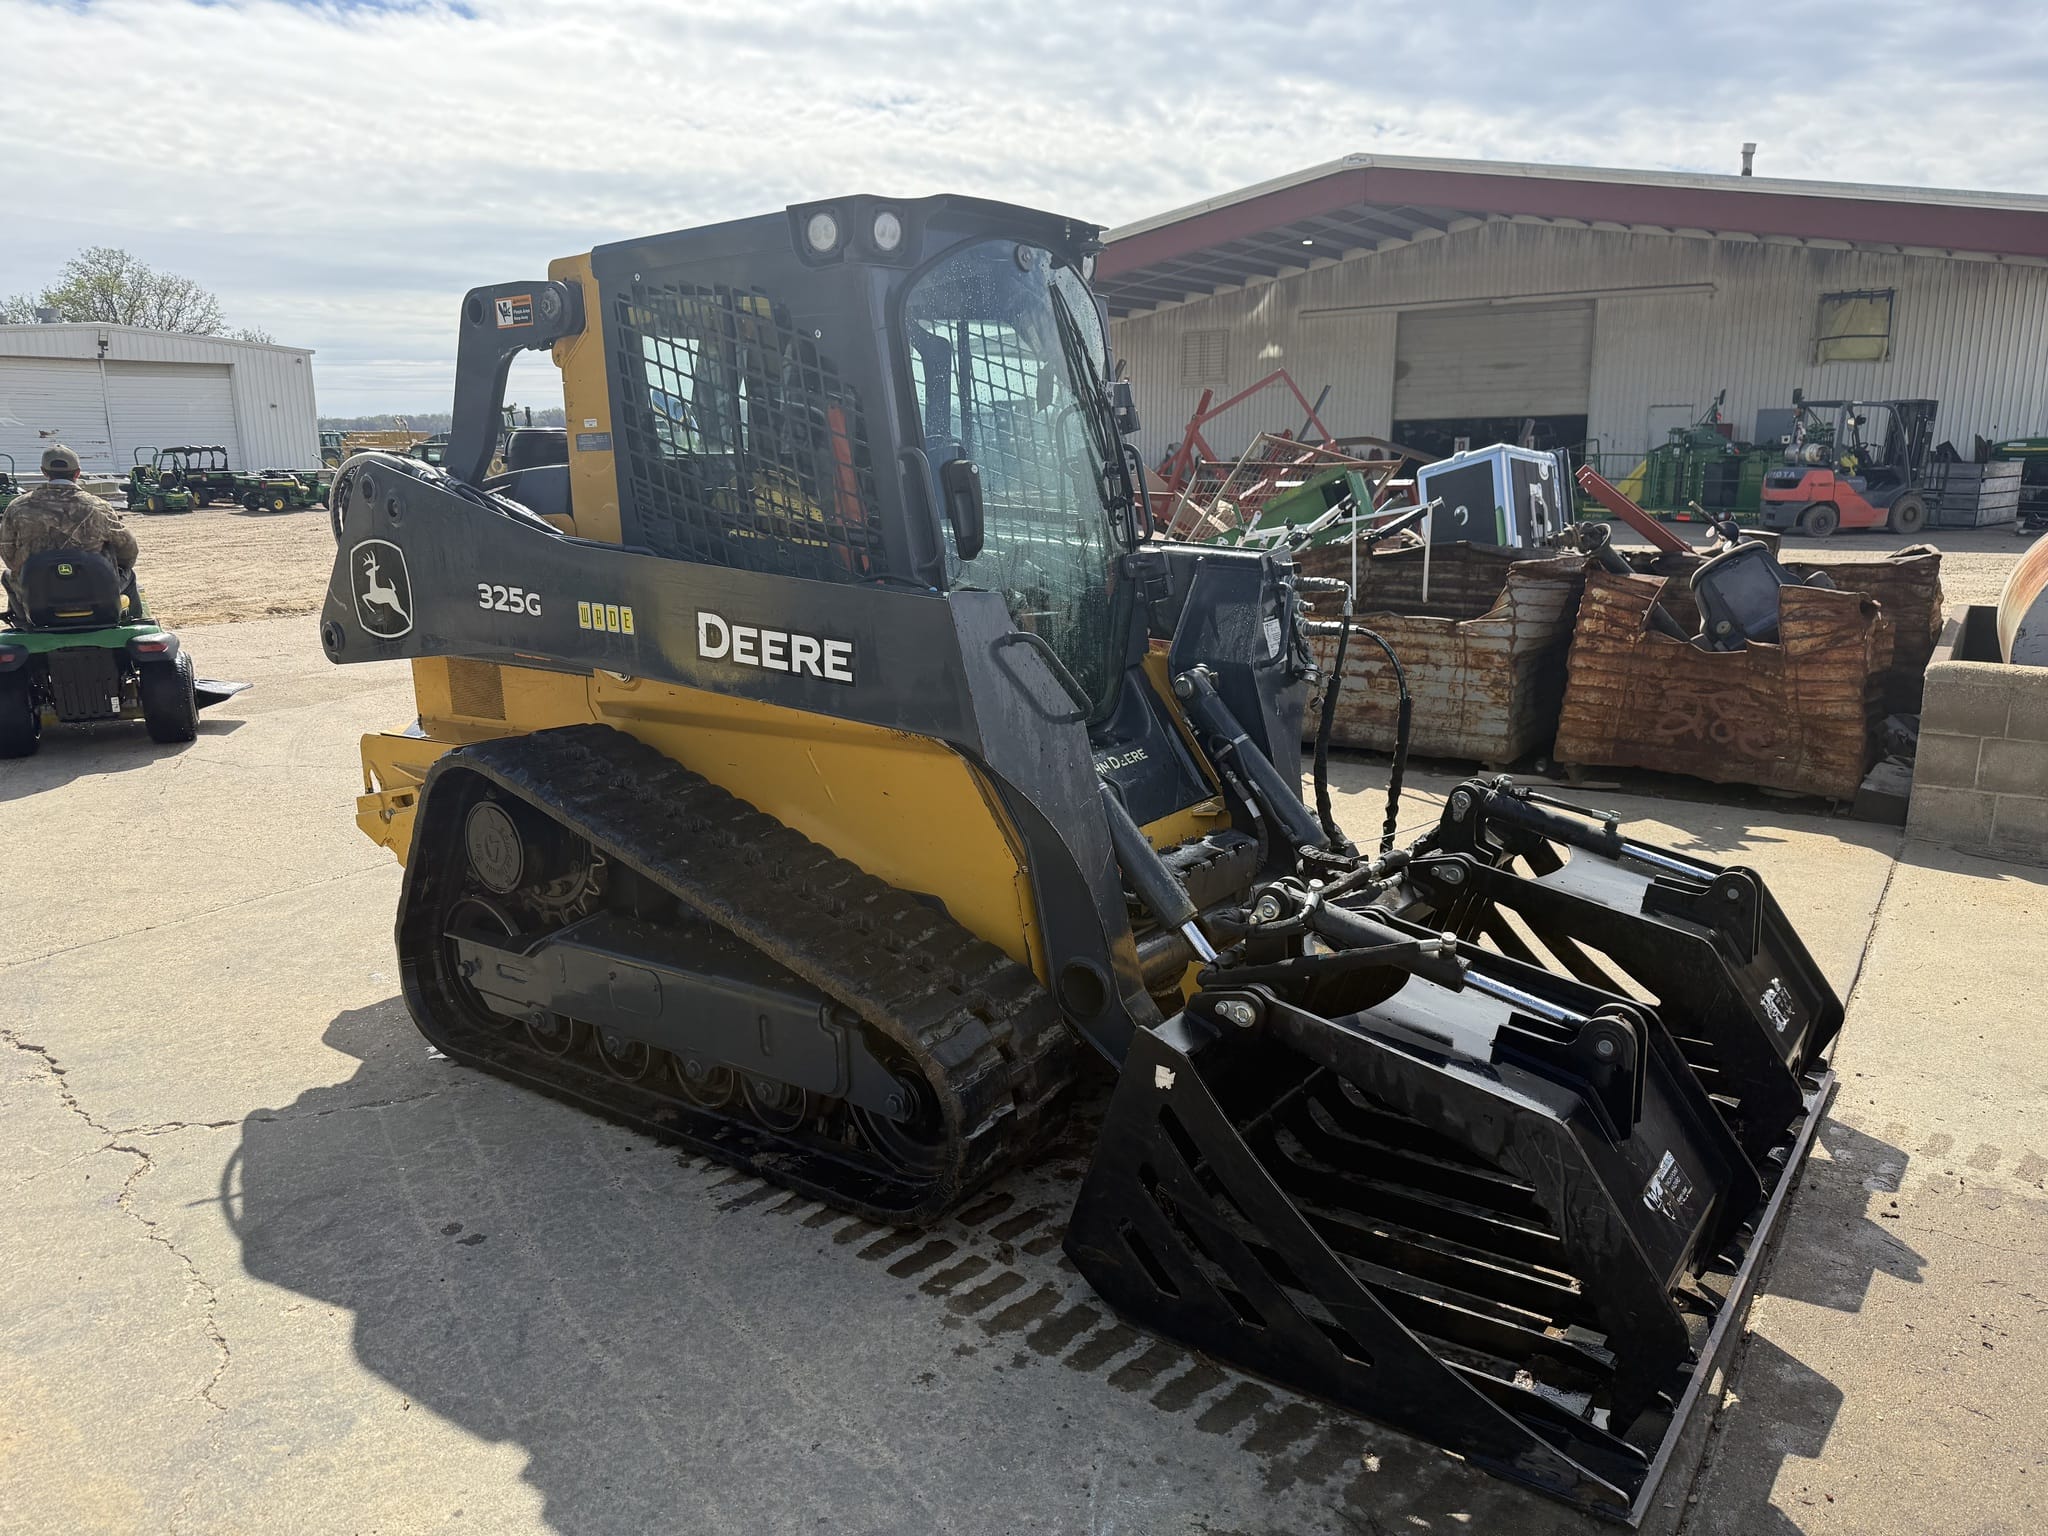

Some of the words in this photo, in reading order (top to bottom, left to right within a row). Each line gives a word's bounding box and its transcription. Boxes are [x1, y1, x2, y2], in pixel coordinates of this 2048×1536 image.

[477, 583, 542, 617] 325G
[579, 605, 632, 631] WADE
[697, 611, 853, 682] DEERE
